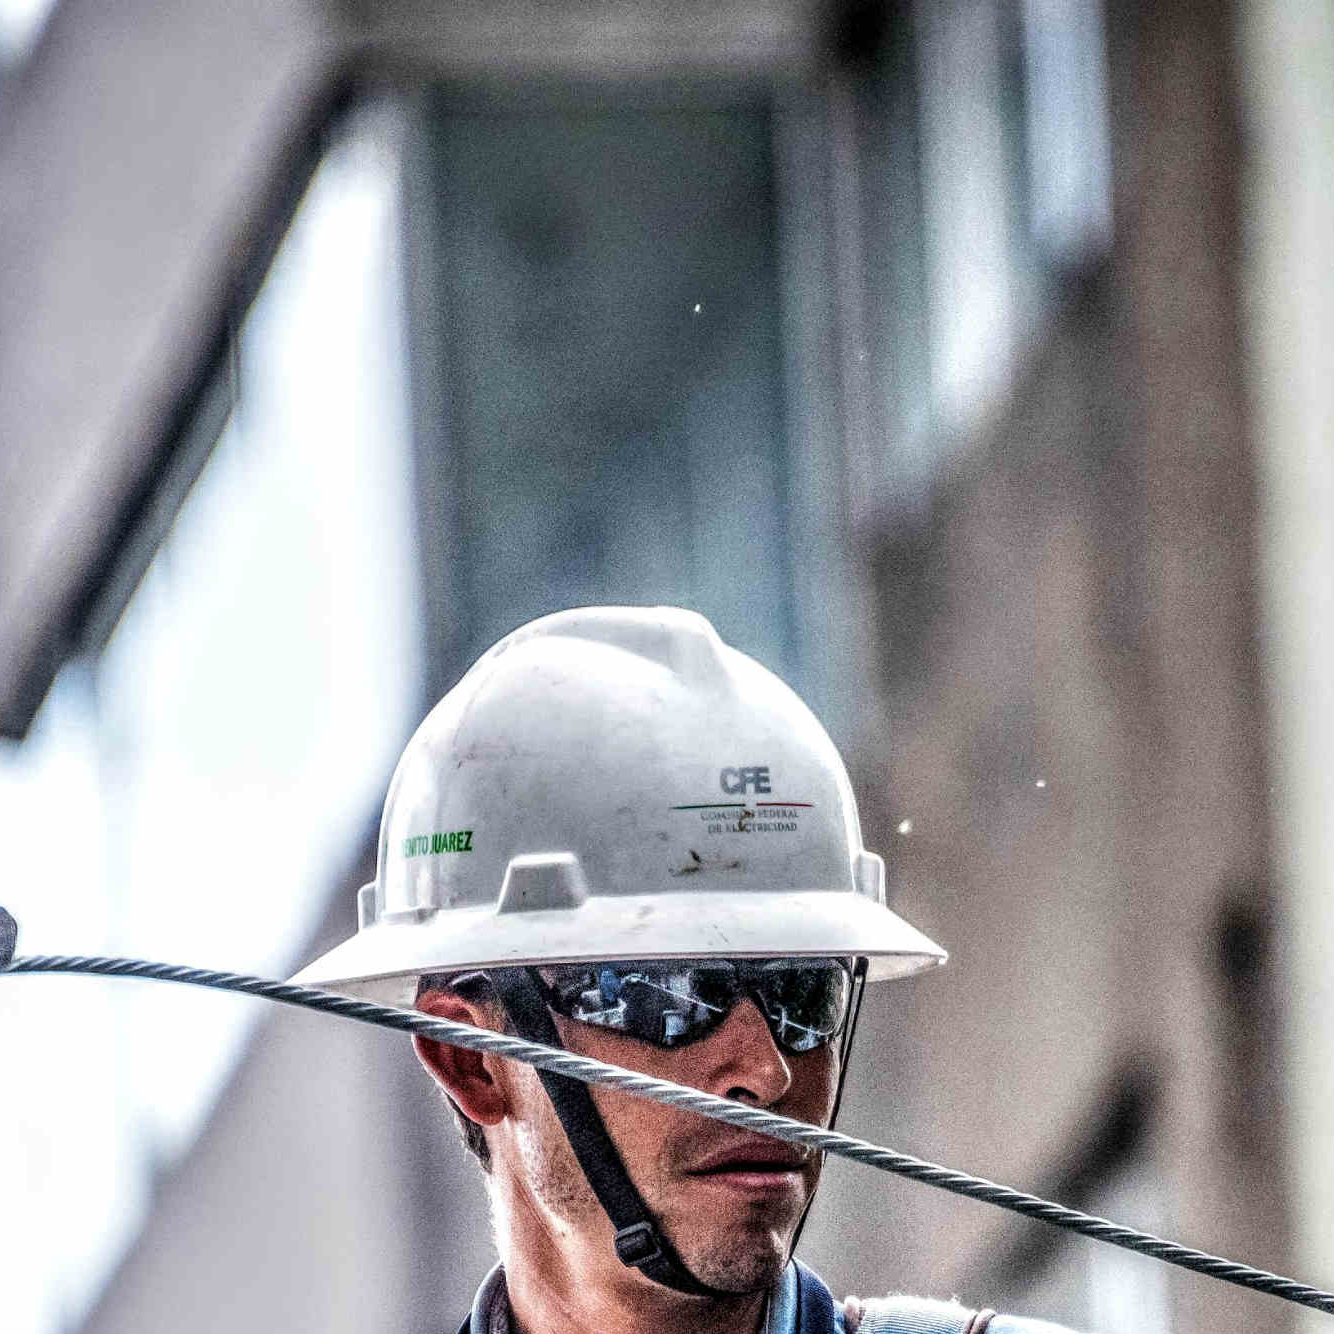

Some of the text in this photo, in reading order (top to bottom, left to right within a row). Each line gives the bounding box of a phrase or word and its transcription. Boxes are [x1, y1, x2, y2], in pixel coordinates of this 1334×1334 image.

[720, 766, 772, 794] CFE
[758, 809, 798, 819] FEDERAL
[430, 830, 473, 855] JUAREZ
